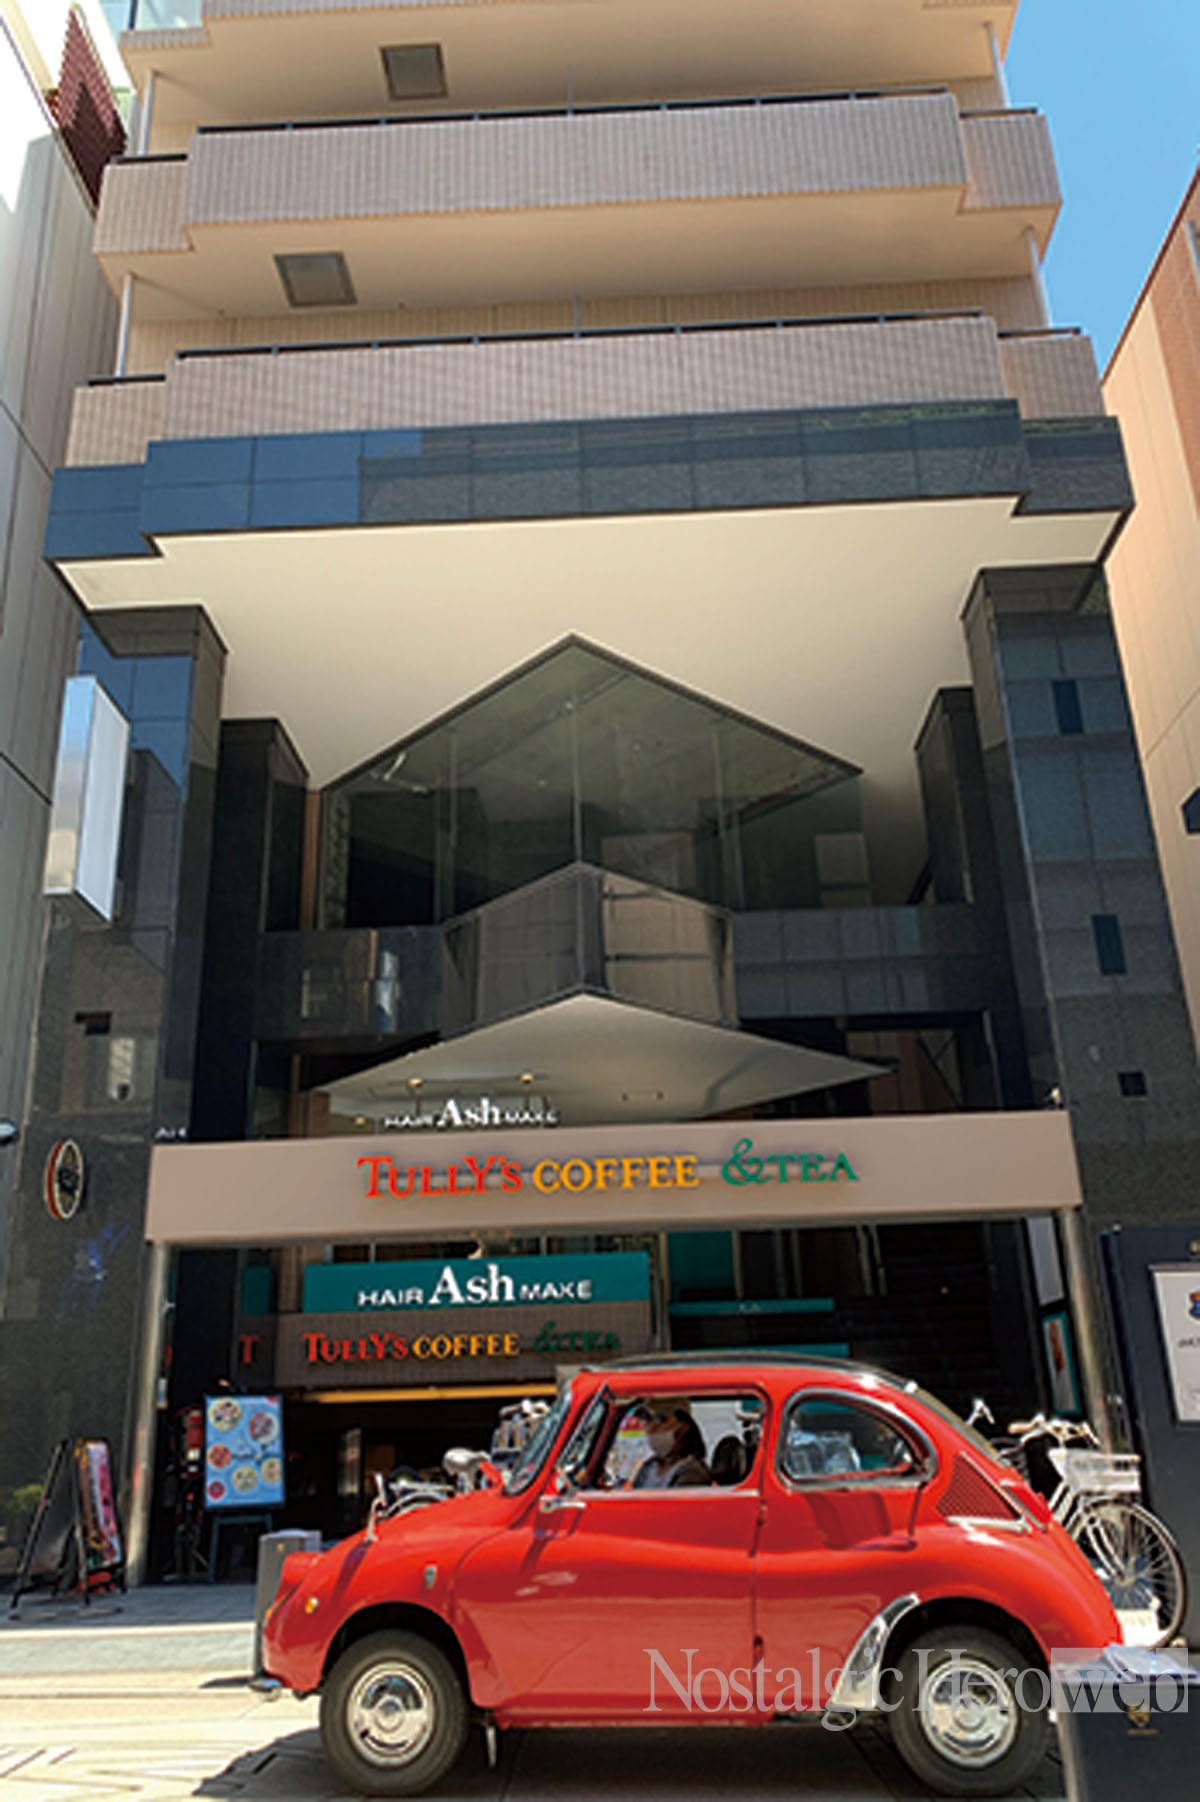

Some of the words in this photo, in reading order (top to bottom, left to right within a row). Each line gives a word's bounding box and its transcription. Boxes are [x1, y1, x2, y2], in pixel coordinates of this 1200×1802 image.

[436, 1097, 500, 1126] Ash
[532, 1155, 699, 1193] COFFEE
[357, 1288, 424, 1306] HAIR
[428, 1263, 516, 1305] Ash
[520, 1279, 592, 1300] MAKE
[413, 1333, 520, 1359] COFFEE
